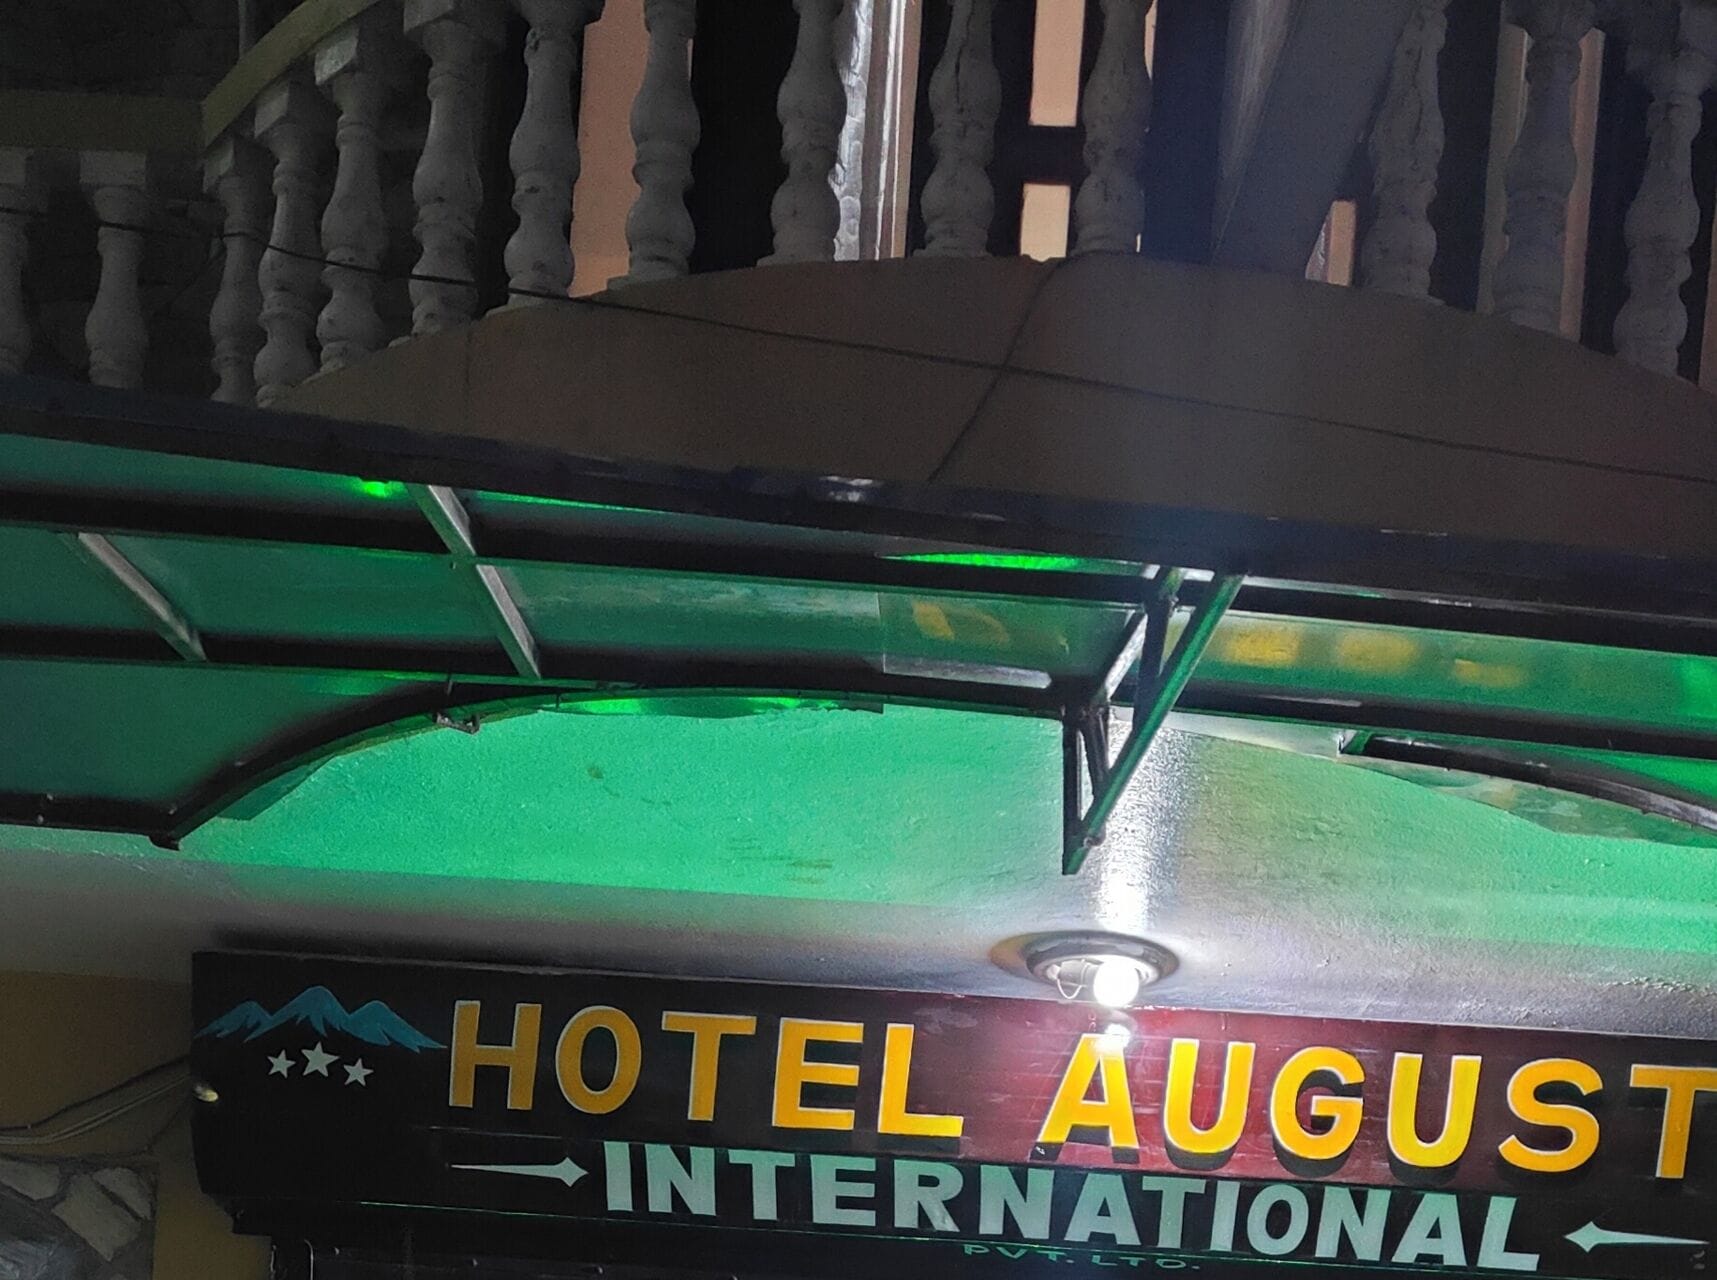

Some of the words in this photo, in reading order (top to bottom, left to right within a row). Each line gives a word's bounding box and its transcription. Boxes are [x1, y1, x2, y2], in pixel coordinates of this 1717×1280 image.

[449, 1000, 964, 1137] HOTEL
[1038, 1033, 1717, 1179] AUGUST
[603, 1141, 1540, 1271] INTERNATIONAL
[963, 1244, 1074, 1263] PVT.
[1092, 1255, 1200, 1269] LTD.
